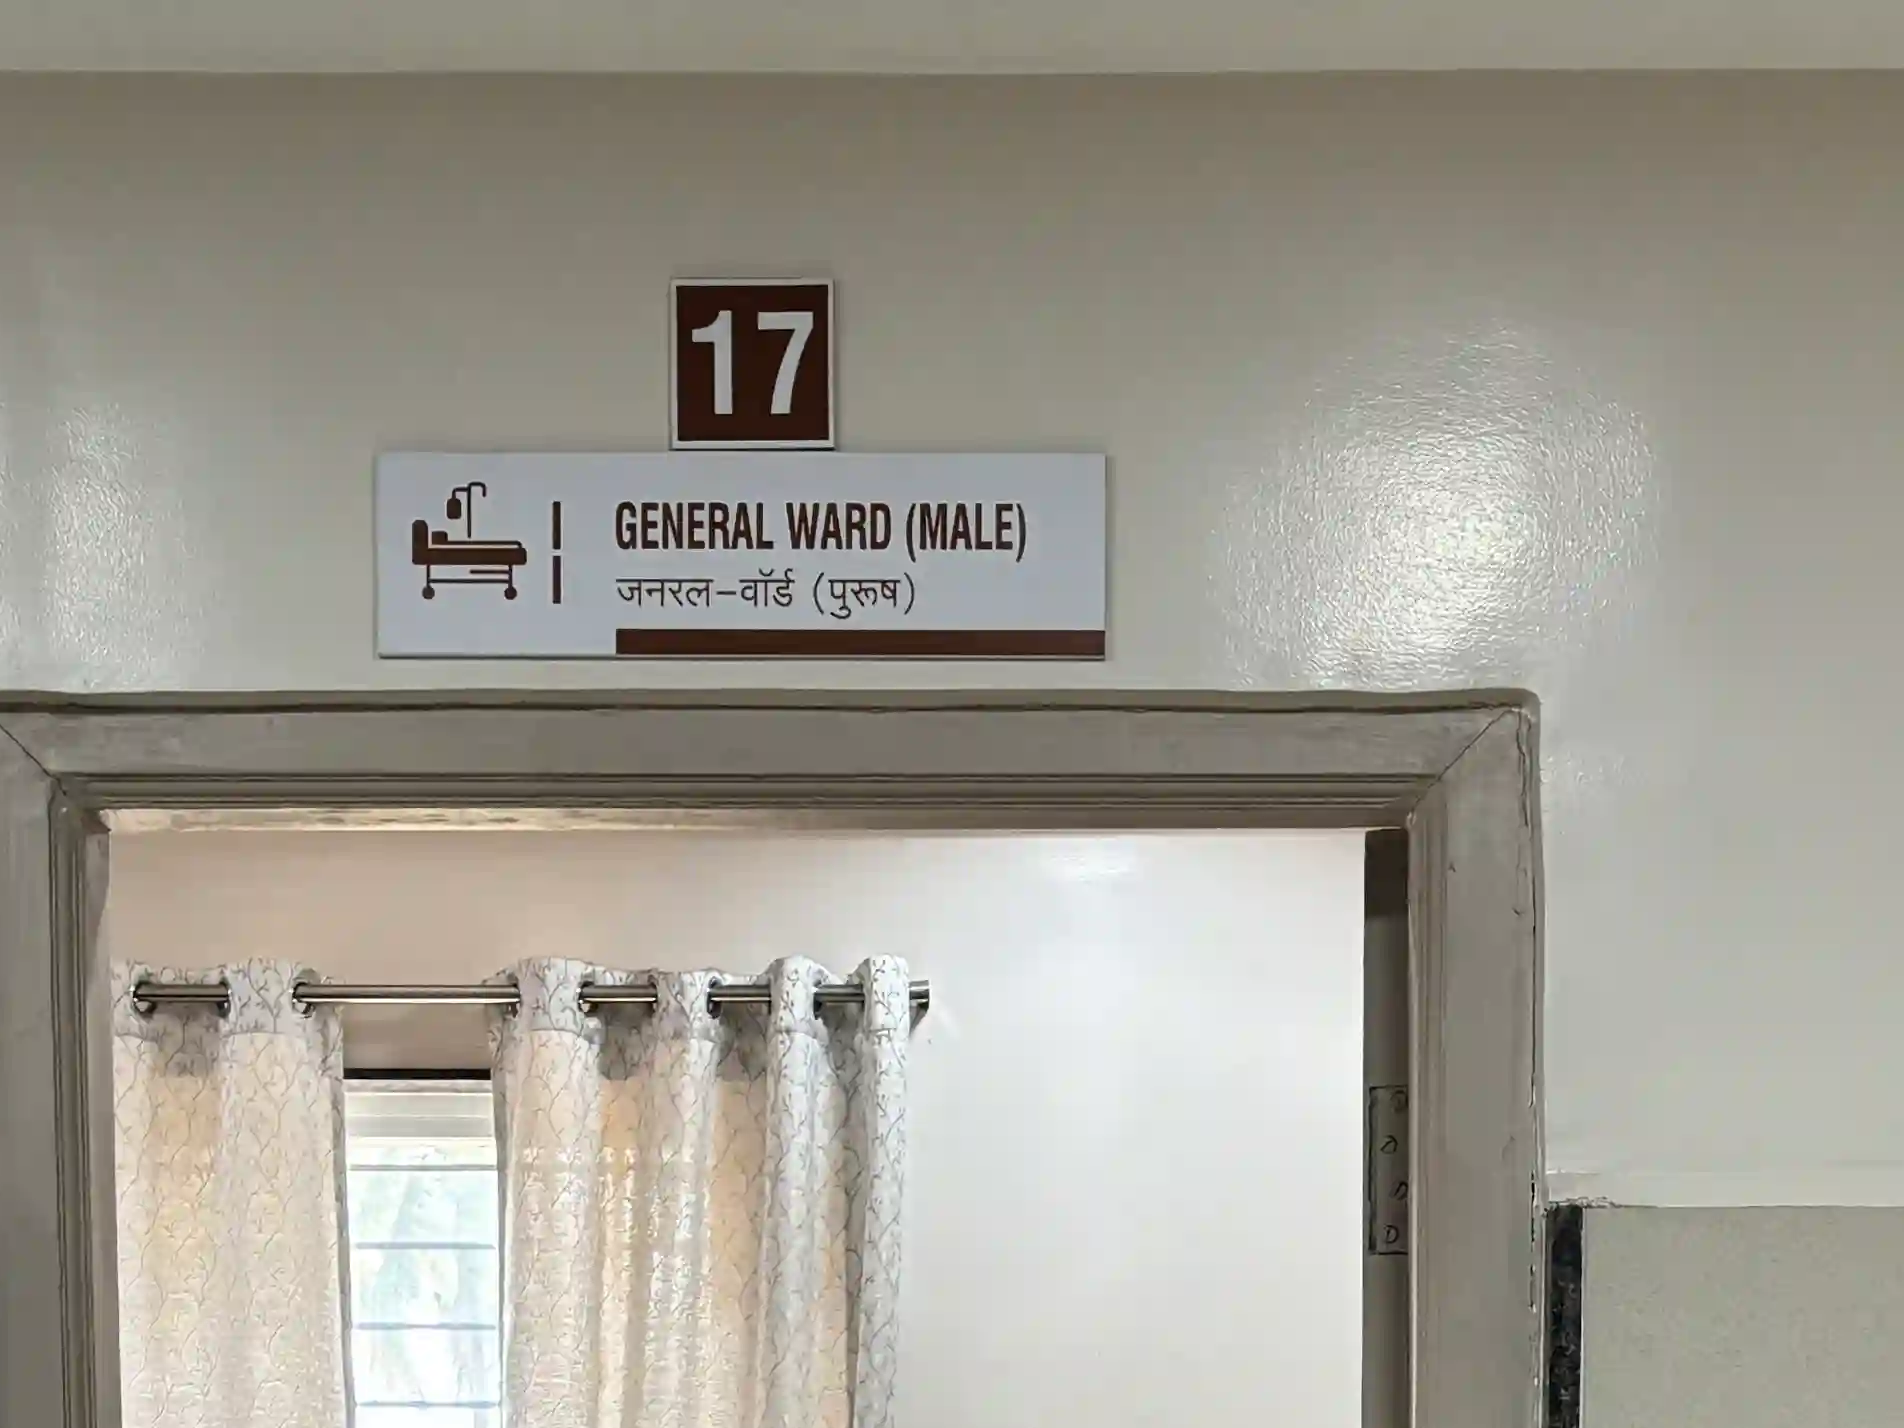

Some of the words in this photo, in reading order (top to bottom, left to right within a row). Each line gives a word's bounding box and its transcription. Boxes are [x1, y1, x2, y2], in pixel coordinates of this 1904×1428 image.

[691, 310, 814, 415] 17
[615, 501, 774, 551] GENERAL
[785, 501, 892, 551] WARD
[905, 501, 1027, 563] (MALE)
